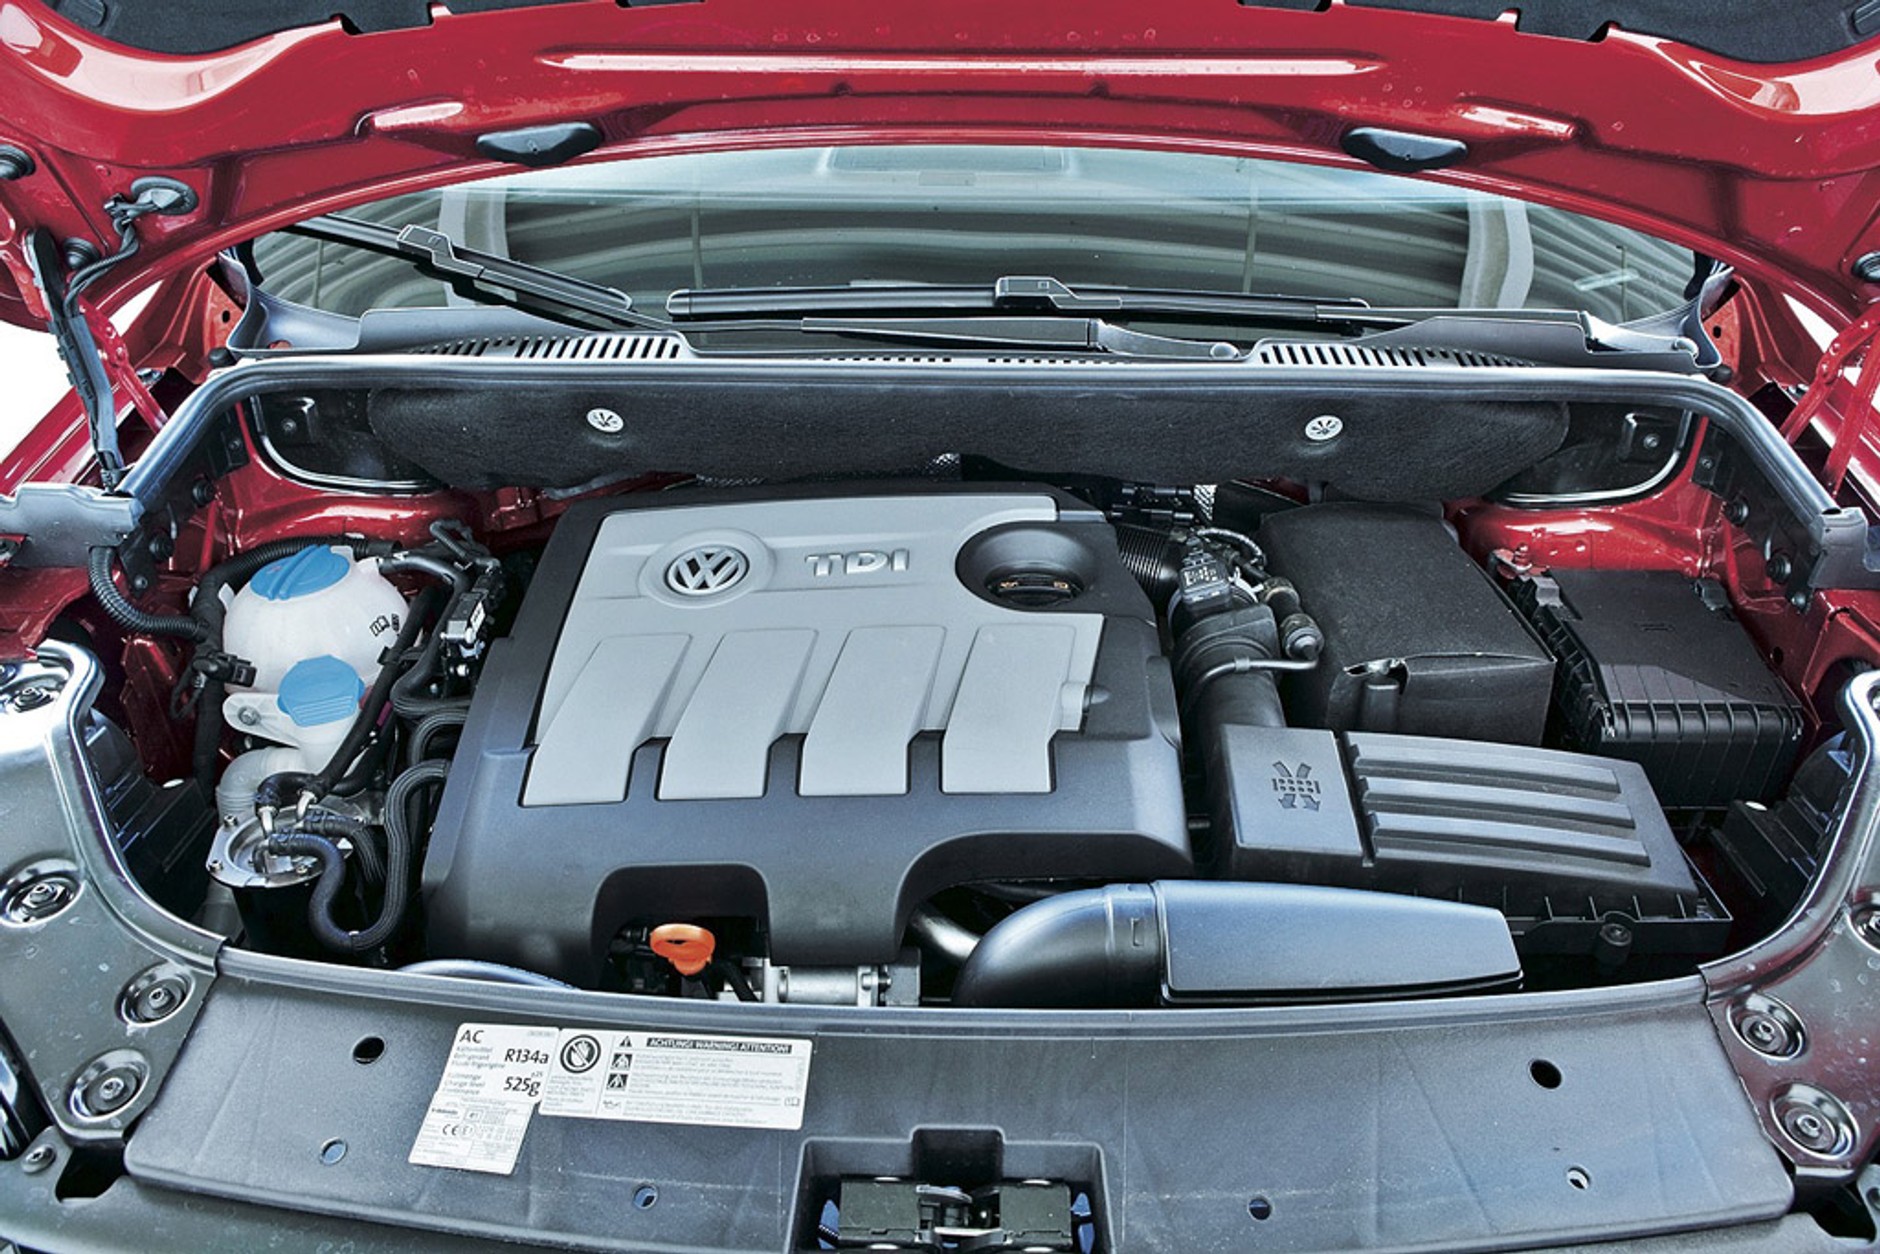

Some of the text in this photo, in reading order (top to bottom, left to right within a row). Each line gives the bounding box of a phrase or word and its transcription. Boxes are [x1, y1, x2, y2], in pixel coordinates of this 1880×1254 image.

[805, 549, 910, 577] TDI
[459, 1029, 484, 1044] AC
[504, 1048, 549, 1064] R134a
[503, 1076, 541, 1097] 525g
